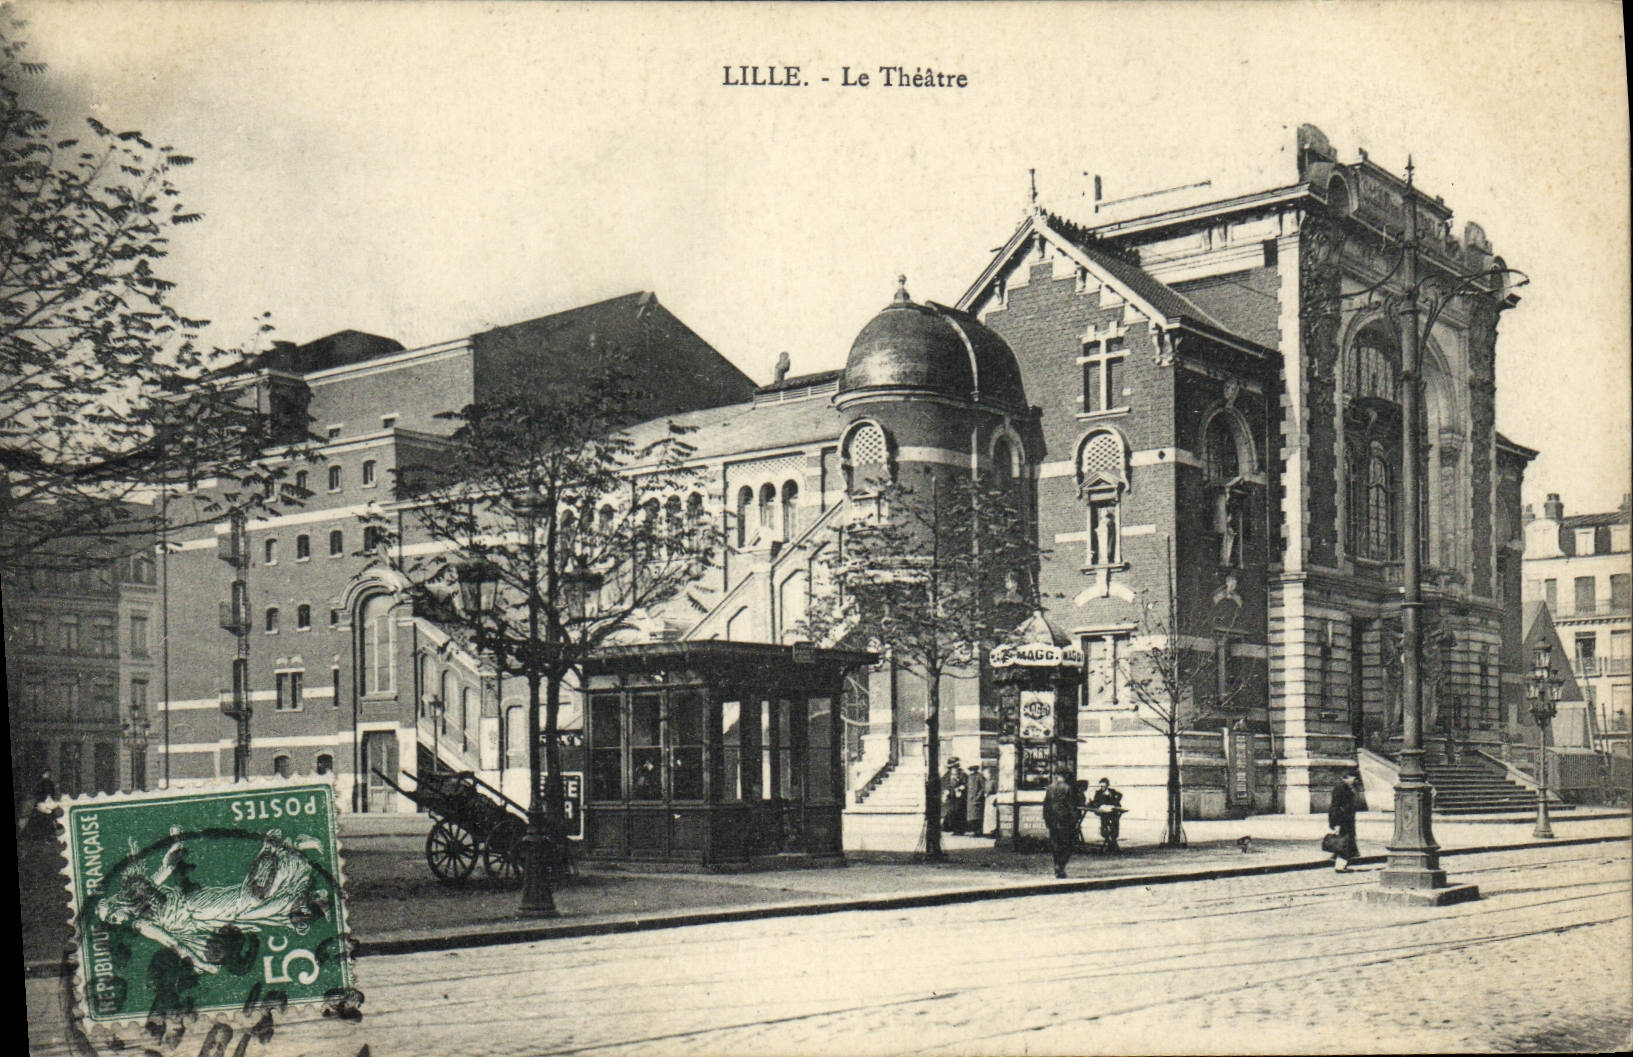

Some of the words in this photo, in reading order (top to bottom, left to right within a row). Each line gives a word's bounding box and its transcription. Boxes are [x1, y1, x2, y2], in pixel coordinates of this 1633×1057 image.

[1016, 649, 1059, 661] MAGG
[231, 795, 316, 821] POSTES
[80, 813, 104, 896] FRANÇAISE
